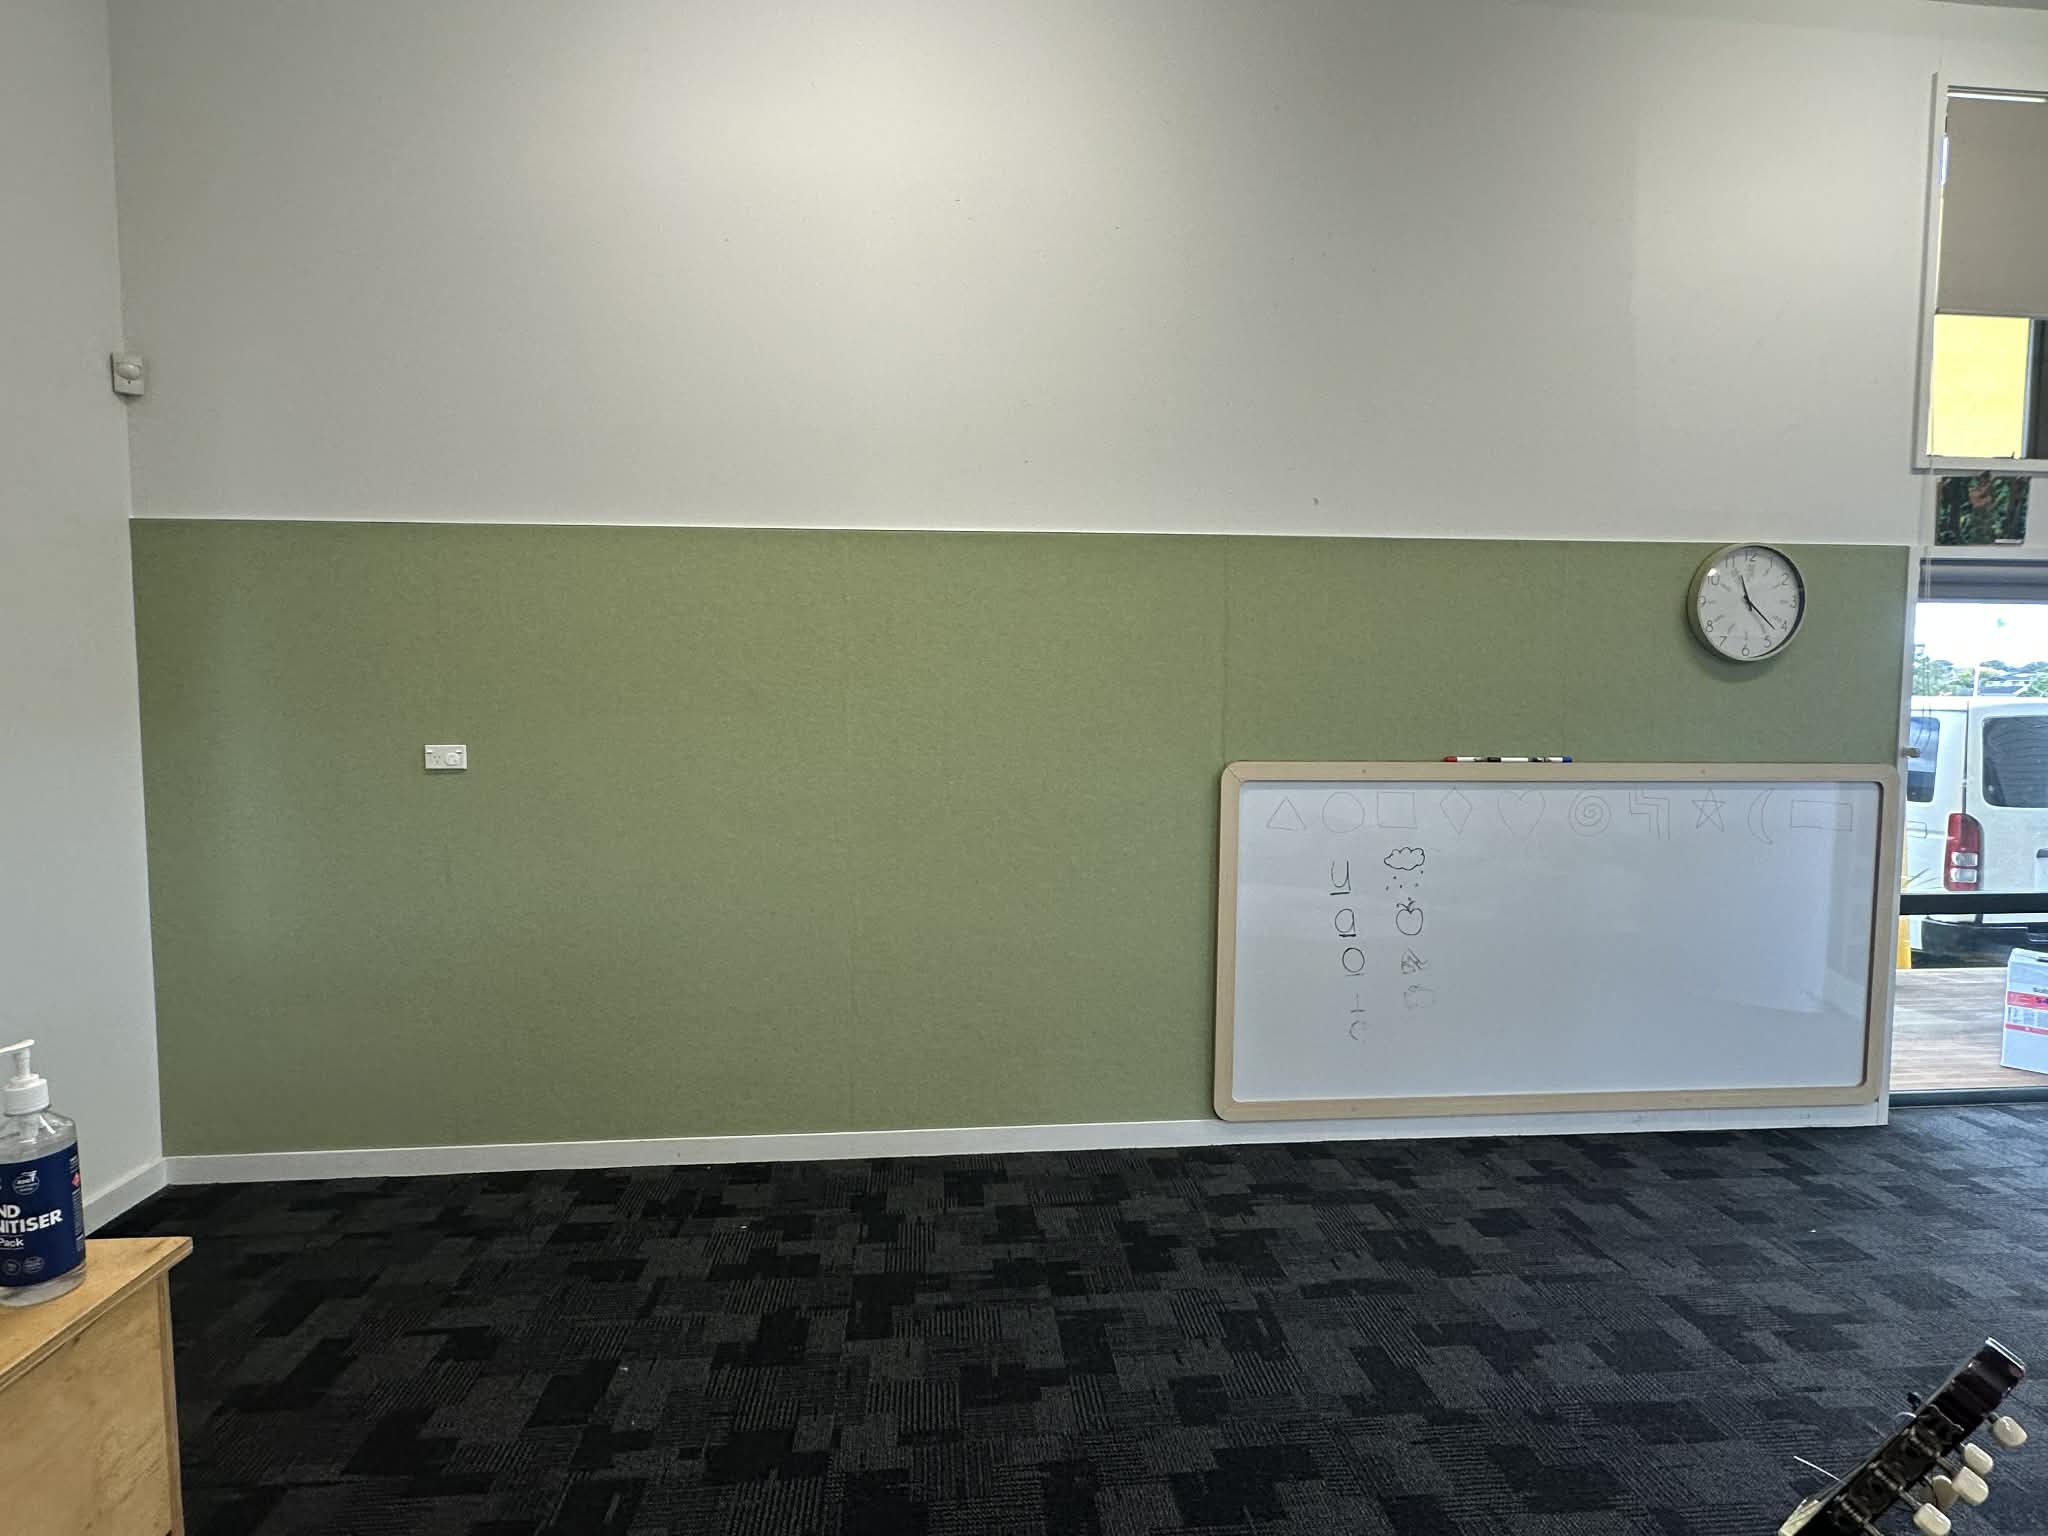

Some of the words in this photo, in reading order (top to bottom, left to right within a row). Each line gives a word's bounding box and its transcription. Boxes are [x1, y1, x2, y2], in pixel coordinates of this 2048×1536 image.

[1725, 555, 1735, 568] 11
[1744, 550, 1759, 562] 12
[1707, 575, 1720, 585] 10
[1781, 572, 1790, 586] 2
[1699, 596, 1706, 608] 9
[1790, 595, 1798, 609] 3
[1705, 619, 1714, 633] 8
[1780, 620, 1788, 632] 4
[1719, 635, 1728, 647] 7
[1763, 635, 1771, 648] 5
[1741, 644, 1750, 657] 6
[1334, 907, 1356, 935] a
